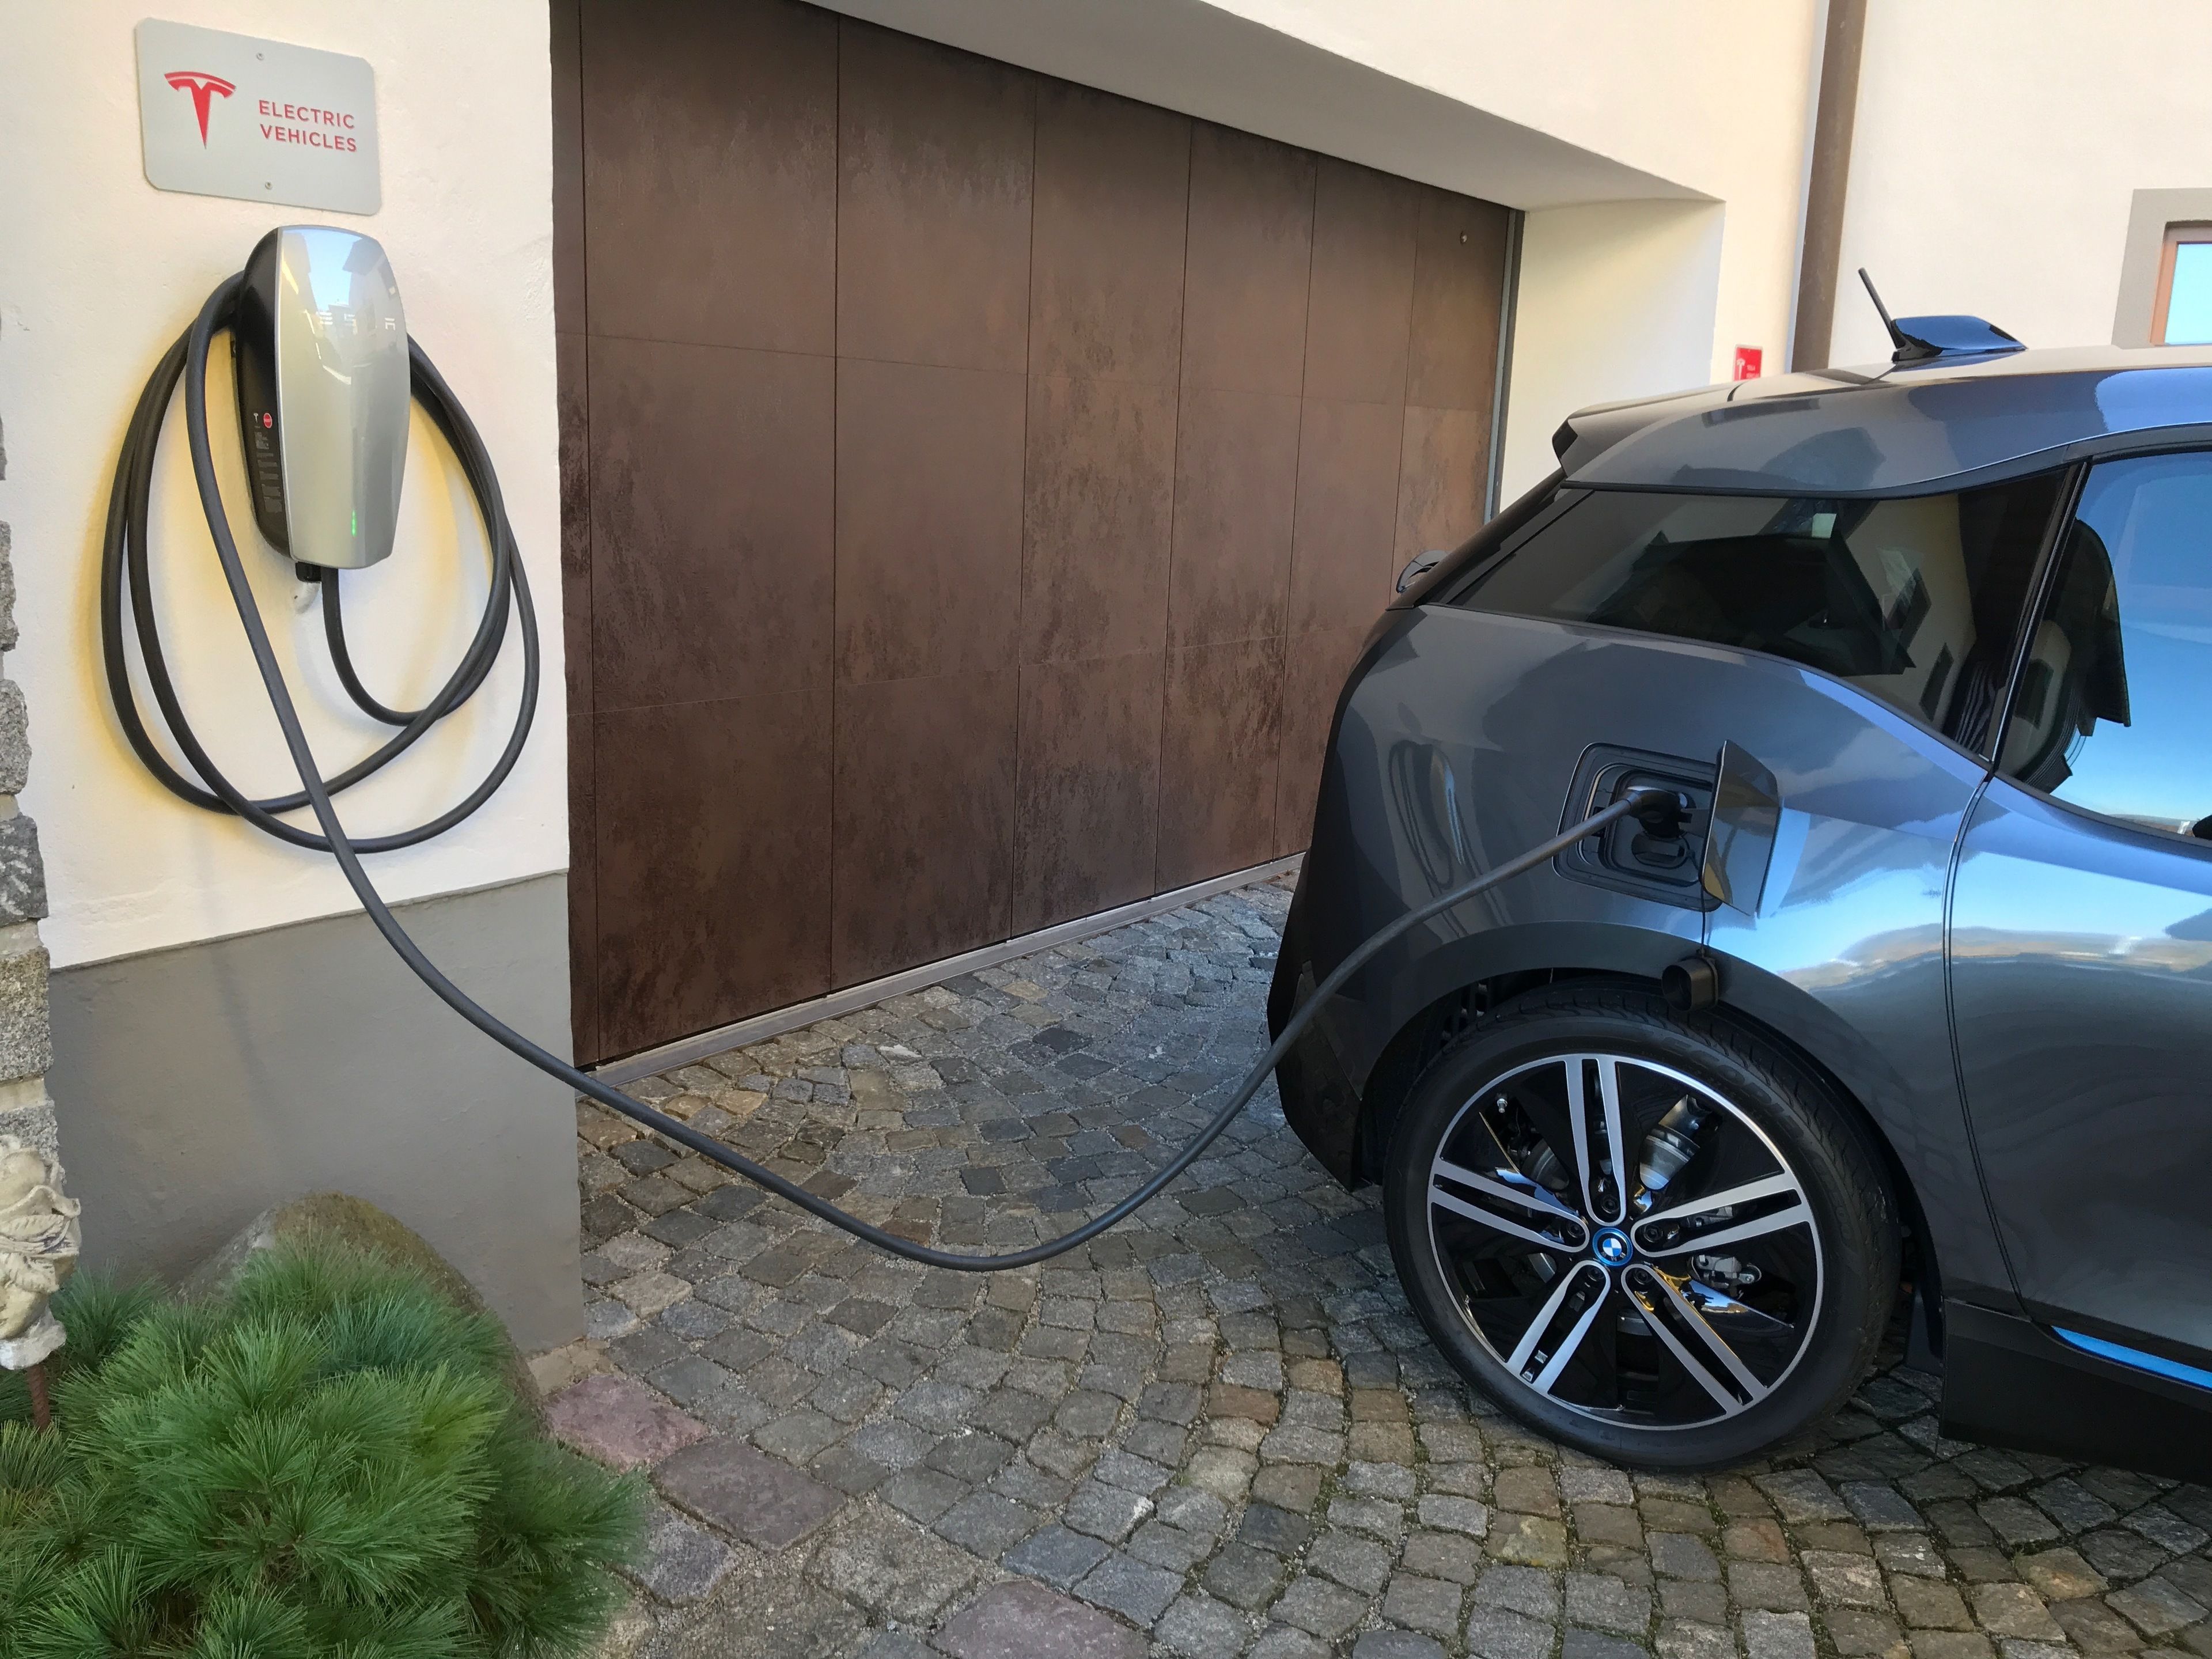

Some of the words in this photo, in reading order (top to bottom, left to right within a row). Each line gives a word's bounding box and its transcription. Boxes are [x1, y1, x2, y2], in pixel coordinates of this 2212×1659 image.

[259, 100, 355, 130] ELECTRIC
[260, 124, 357, 153] VEHICLES
[1660, 1035, 1804, 1141] ECOPIA
